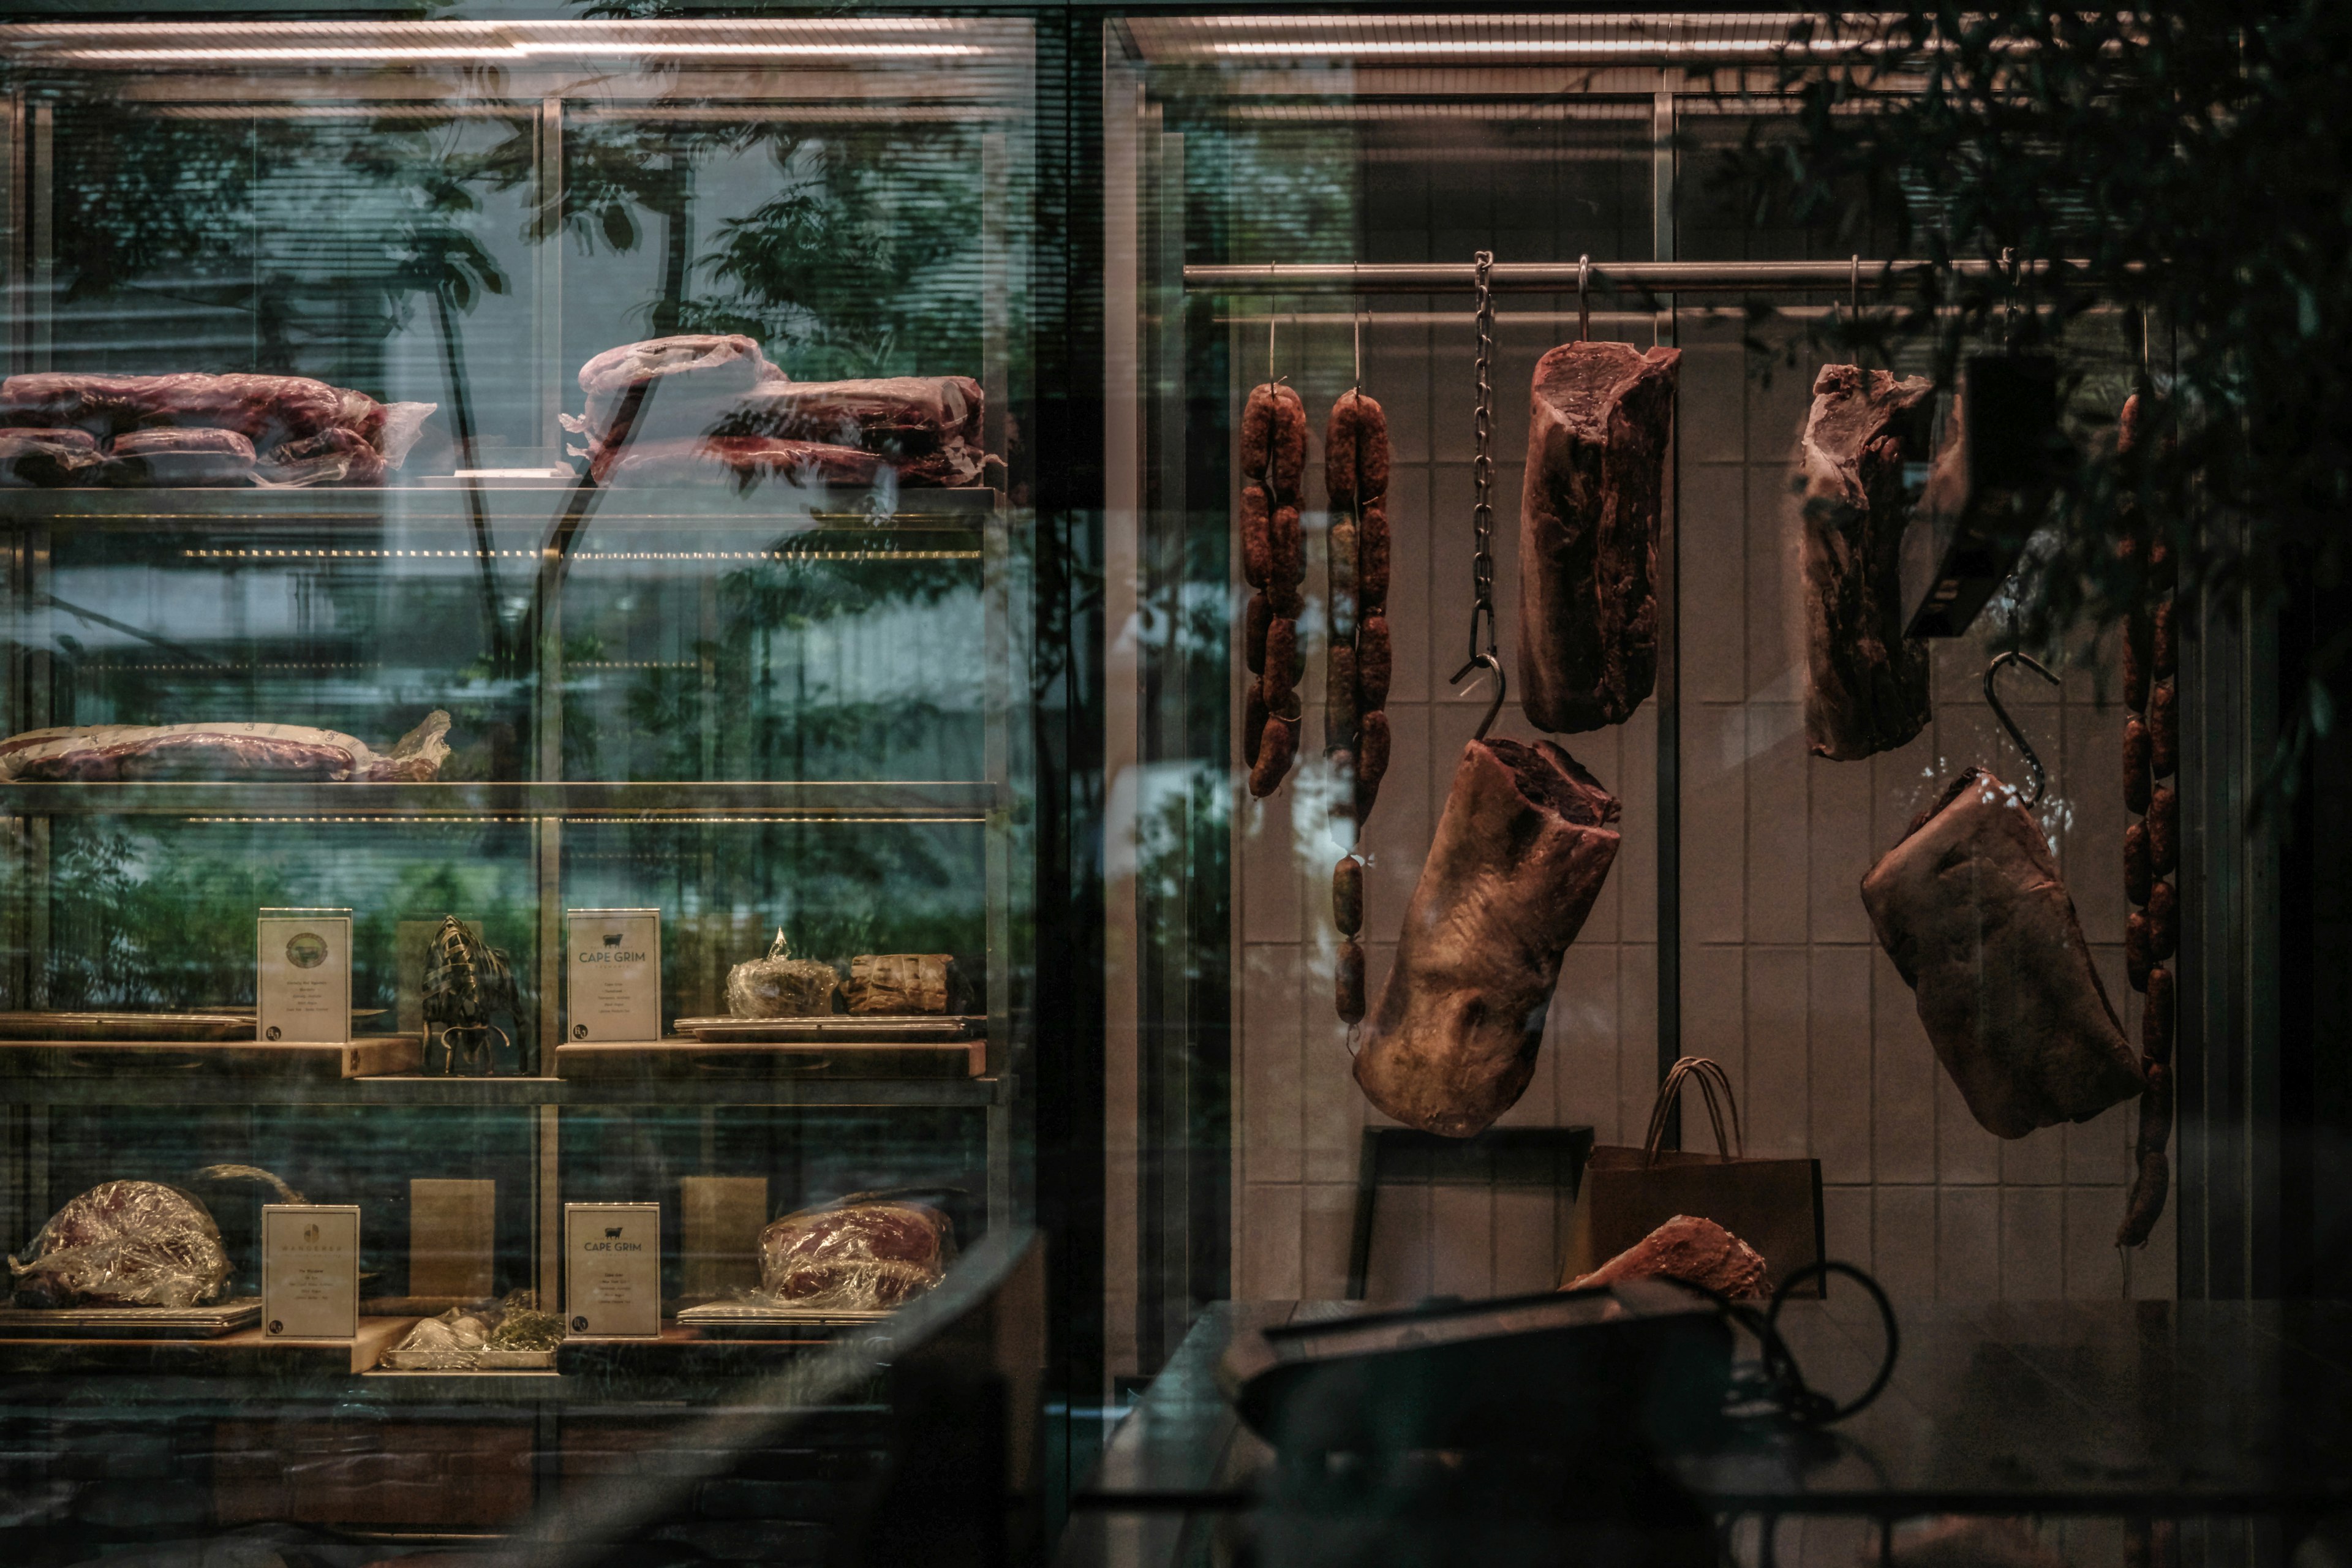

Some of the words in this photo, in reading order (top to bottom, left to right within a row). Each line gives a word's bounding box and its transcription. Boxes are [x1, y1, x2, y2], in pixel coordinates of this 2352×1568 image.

[579, 952, 611, 963] CAPE
[614, 951, 646, 962] GRIM
[584, 1242, 611, 1251] CAPE
[614, 1242, 642, 1251] GRIM
